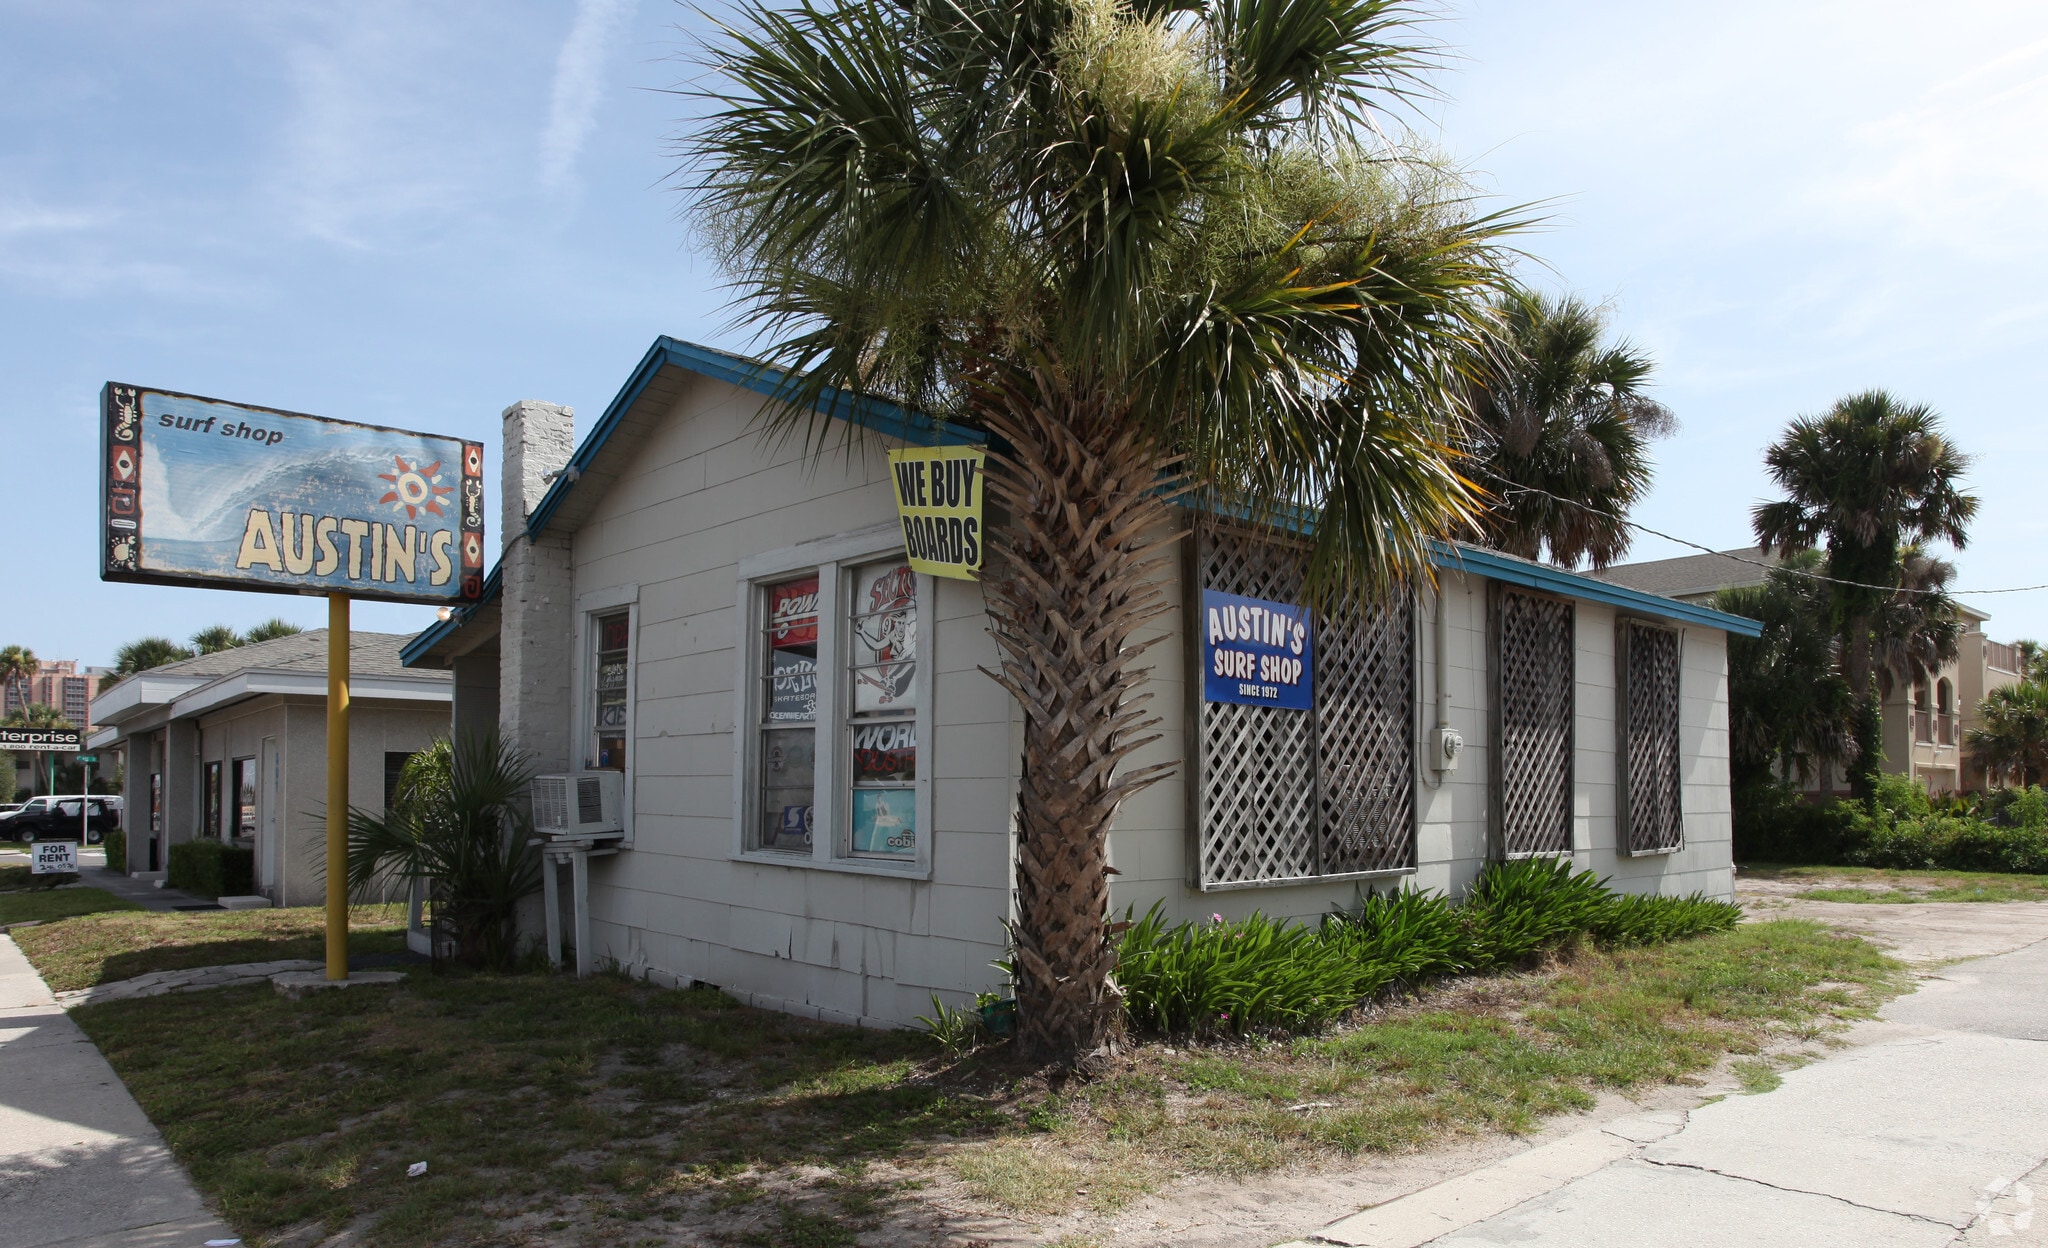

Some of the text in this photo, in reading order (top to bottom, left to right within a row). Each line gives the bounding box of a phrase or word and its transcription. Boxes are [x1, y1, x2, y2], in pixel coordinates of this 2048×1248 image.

[159, 413, 283, 447] surf shop
[894, 458, 977, 508] WE BUY
[235, 508, 453, 587] AUSTIN'S
[902, 515, 978, 567] BOARDS
[1208, 604, 1306, 656] AUSTIN'S
[1213, 647, 1303, 685] SURF SHOP
[1238, 683, 1278, 699] SINCE 1972
[39, 854, 70, 863] RENT
[43, 845, 66, 853] FOR
